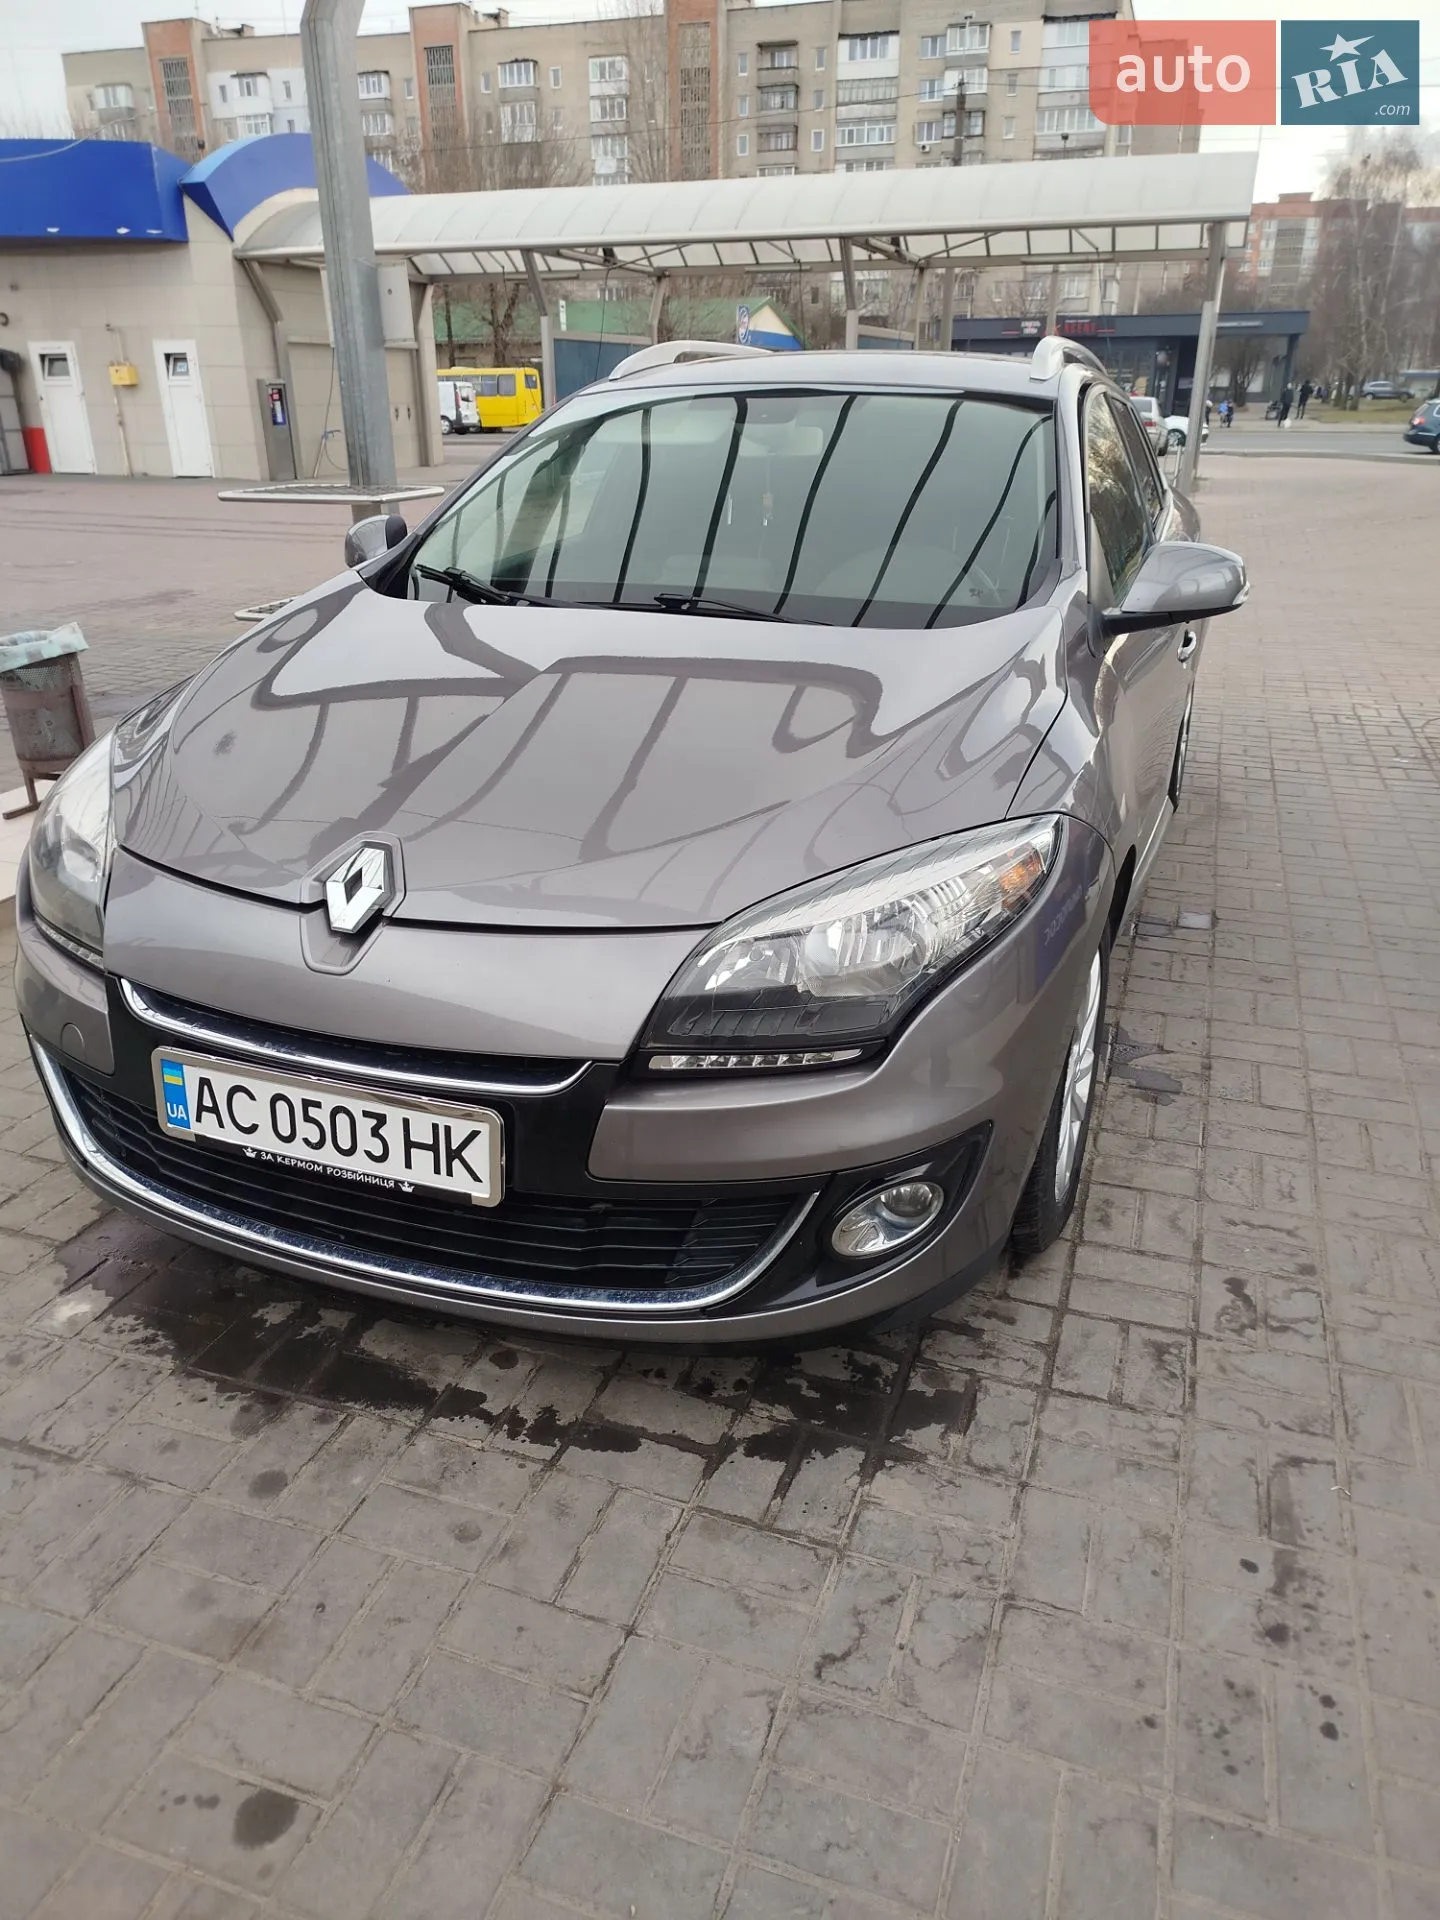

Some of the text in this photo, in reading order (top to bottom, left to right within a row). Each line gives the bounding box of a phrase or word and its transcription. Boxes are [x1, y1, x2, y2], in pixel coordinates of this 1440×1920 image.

[167, 1102, 188, 1121] UA
[195, 1076, 483, 1184] AC 0503 HK
[260, 1151, 395, 1189] ЗА КЕРМОМ РОЗБІЙНИЦЯ
